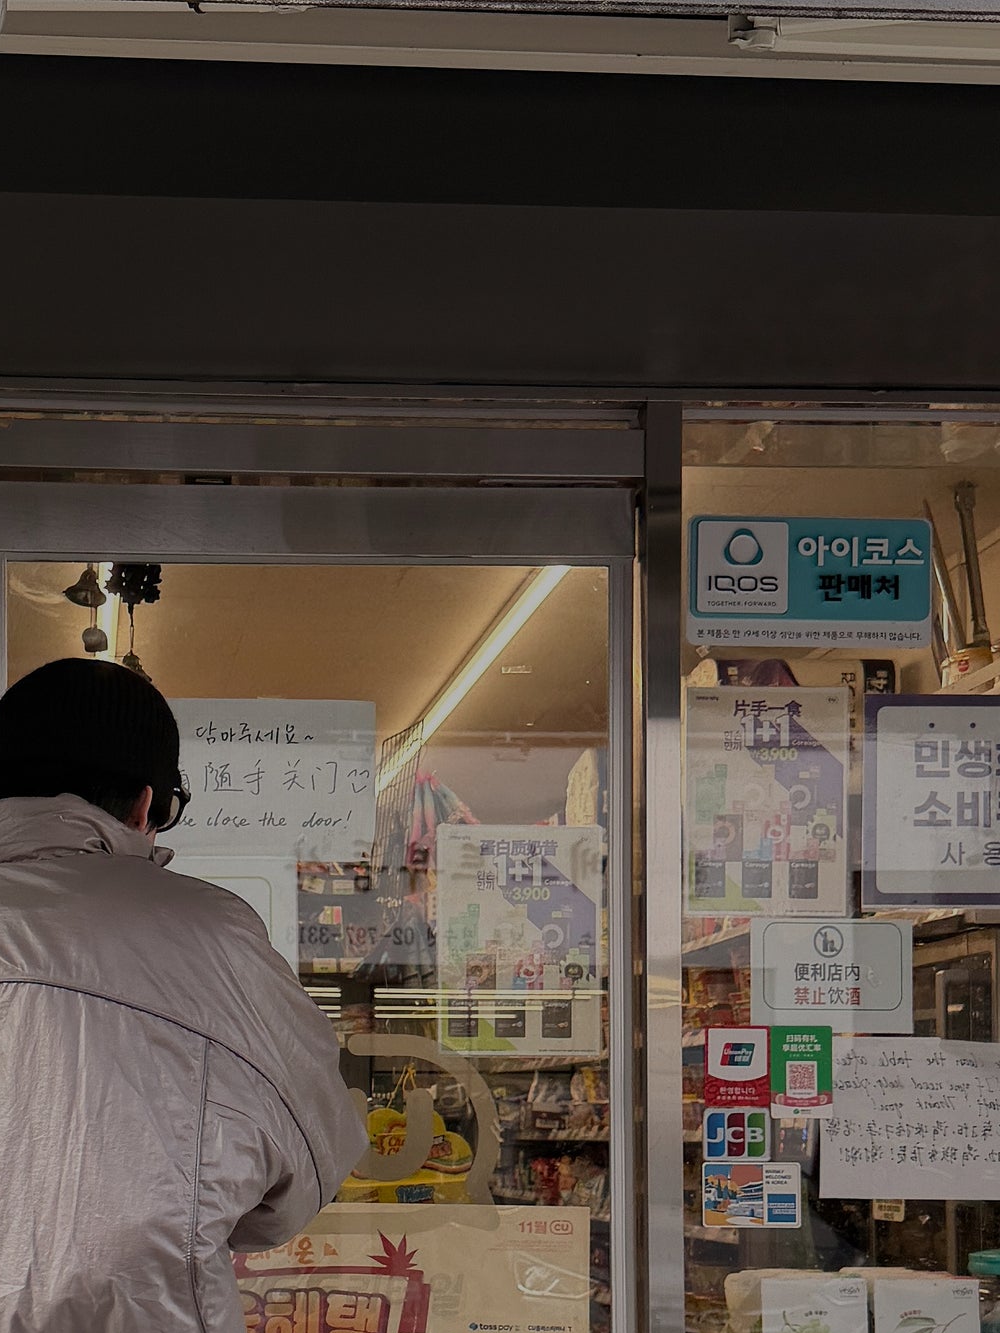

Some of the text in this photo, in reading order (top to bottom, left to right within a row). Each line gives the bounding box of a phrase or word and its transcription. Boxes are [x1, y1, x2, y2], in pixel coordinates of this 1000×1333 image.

[798, 535, 925, 567] 아이코스
[708, 575, 778, 593] IQOS
[819, 574, 900, 602] 판매처
[696, 629, 704, 638] 본
[706, 629, 730, 639] 제품은
[732, 629, 740, 639] 만
[743, 629, 760, 639] 19세
[761, 630, 777, 640] 이상
[805, 630, 820, 640] 위한
[822, 630, 853, 640] 제품으로
[856, 631, 887, 640] 무해하지
[734, 700, 802, 717] 片手一食
[740, 713, 791, 748] 1+1
[914, 741, 1000, 779] 민생
[207, 808, 353, 829] close the door!
[914, 791, 1000, 828] 소비
[480, 839, 558, 857] 蛋白质奶昔
[493, 855, 543, 887] 1+1
[794, 962, 860, 982] 便利店内
[794, 986, 861, 1006] 禁止饮酒
[719, 1086, 756, 1095] 환영합니다
[707, 1127, 764, 1143] JCB
[518, 1221, 569, 1235] 11월 CU
[479, 1323, 513, 1333] toss pay
